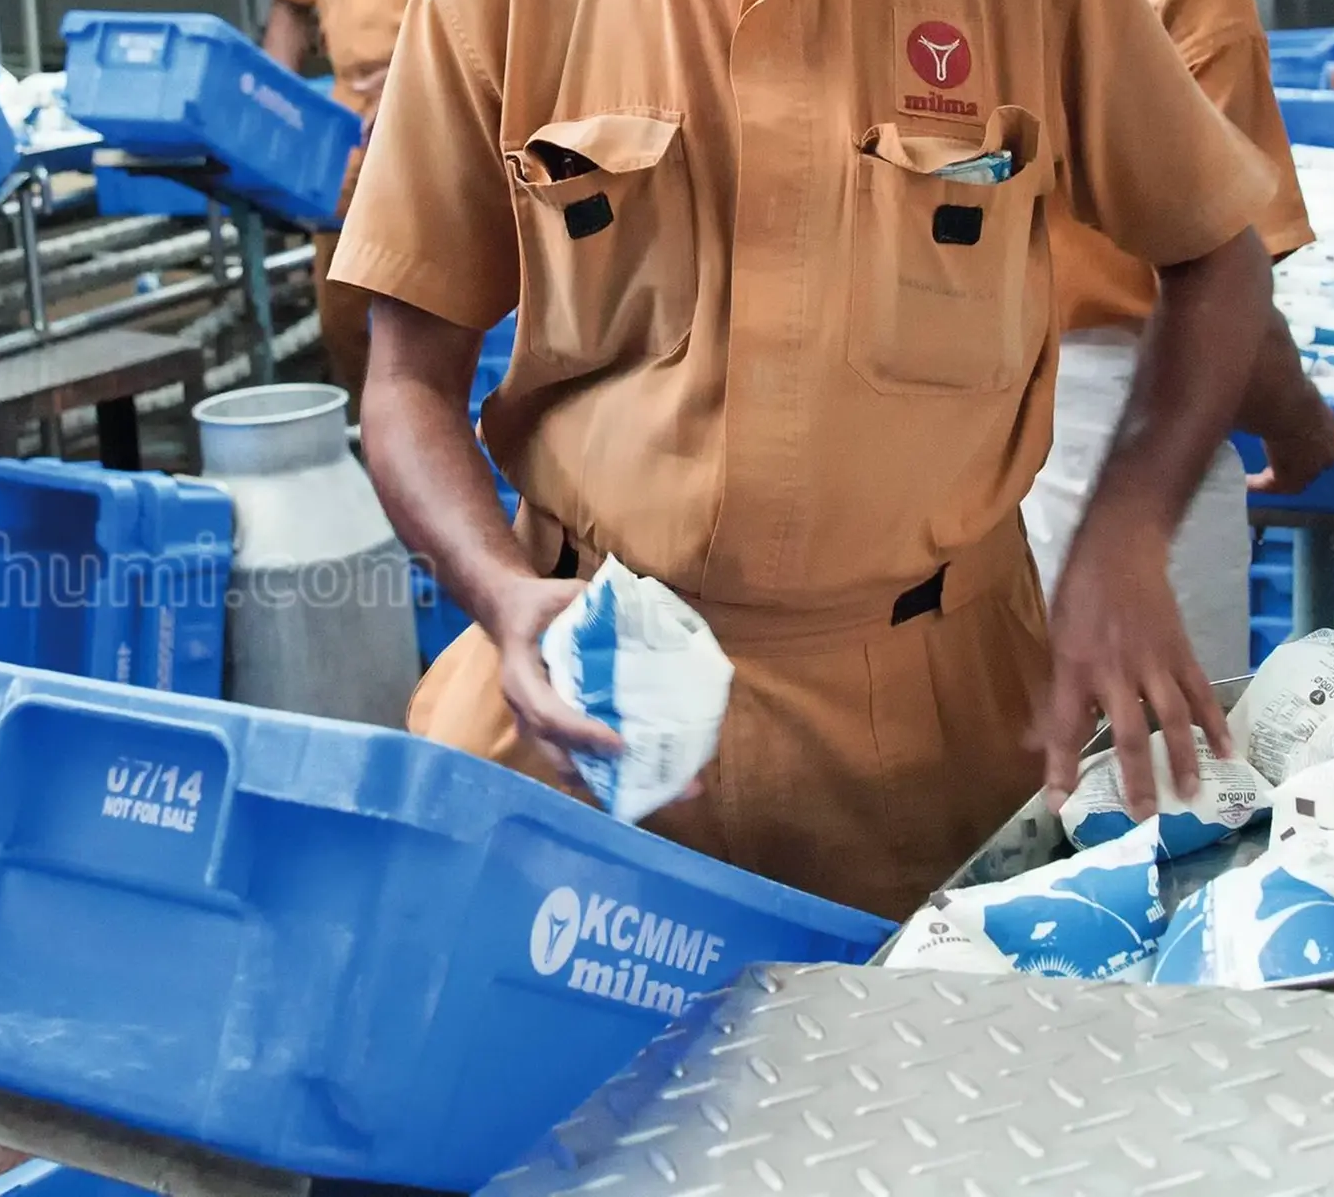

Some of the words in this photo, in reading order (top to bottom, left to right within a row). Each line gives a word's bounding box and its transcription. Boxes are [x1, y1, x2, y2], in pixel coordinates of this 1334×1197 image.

[904, 90, 978, 117] milma
[107, 756, 204, 808] 07/14
[101, 795, 134, 820] NOT
[130, 798, 161, 826] FOR
[161, 805, 198, 834] SALE
[579, 893, 725, 976] KCMMF
